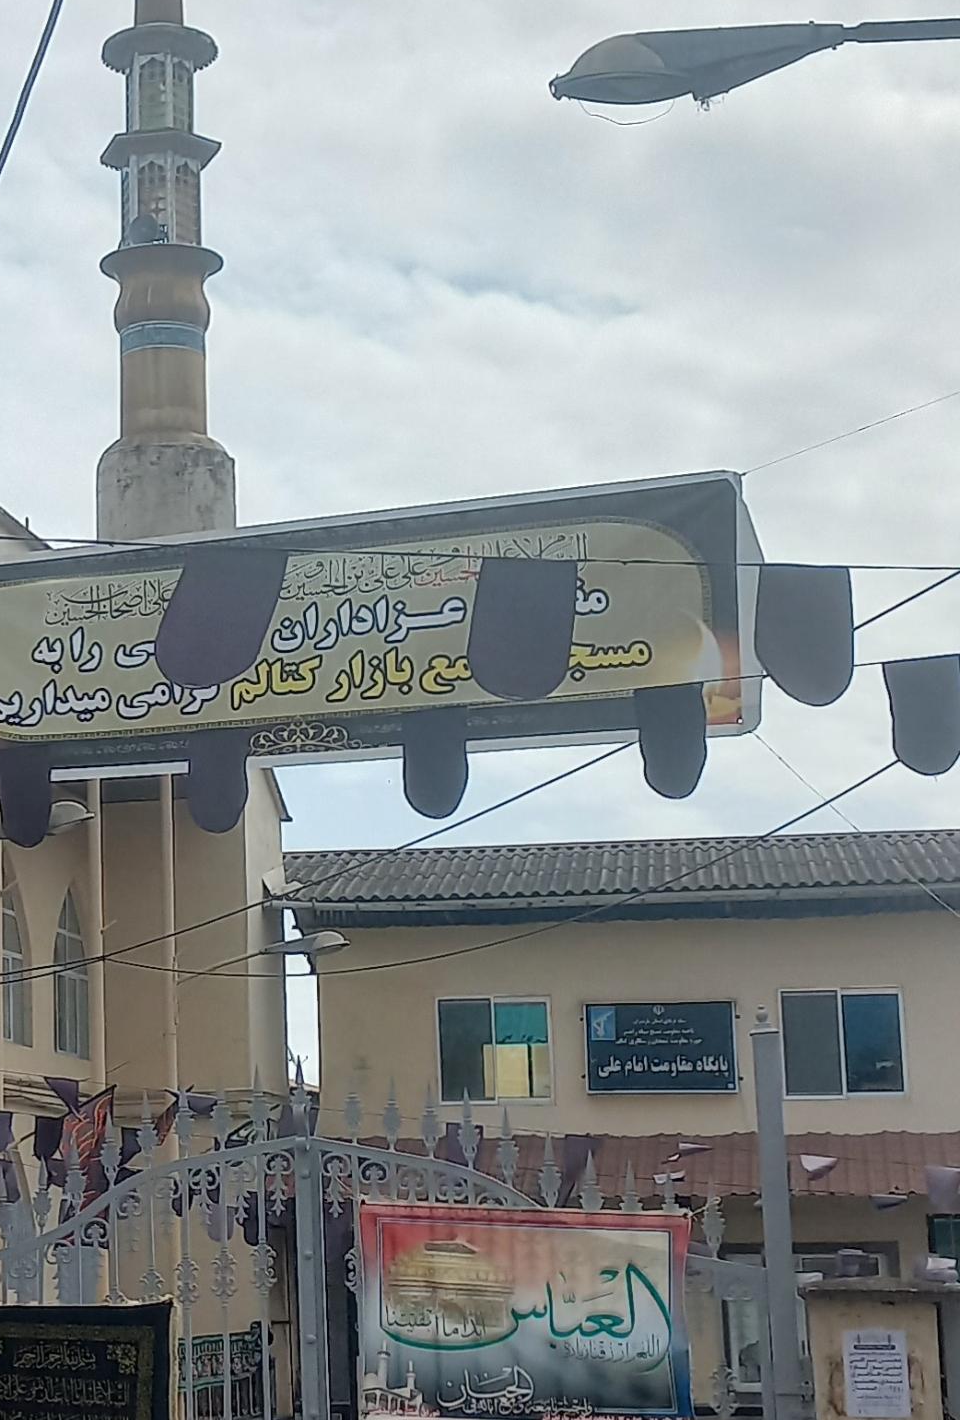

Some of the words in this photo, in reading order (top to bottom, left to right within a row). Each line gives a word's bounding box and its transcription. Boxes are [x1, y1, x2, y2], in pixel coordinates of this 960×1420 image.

[575, 578, 609, 616] مق
[32, 636, 63, 673] به
[71, 626, 102, 671] را
[568, 640, 652, 682] مسج
[230, 654, 323, 711] کتالم
[326, 647, 415, 702] بازار
[420, 659, 475, 694] مع
[598, 1055, 622, 1078] علی
[625, 1055, 648, 1077] امام
[650, 1055, 693, 1077] مقاومت
[696, 1055, 729, 1077] پایگاه
